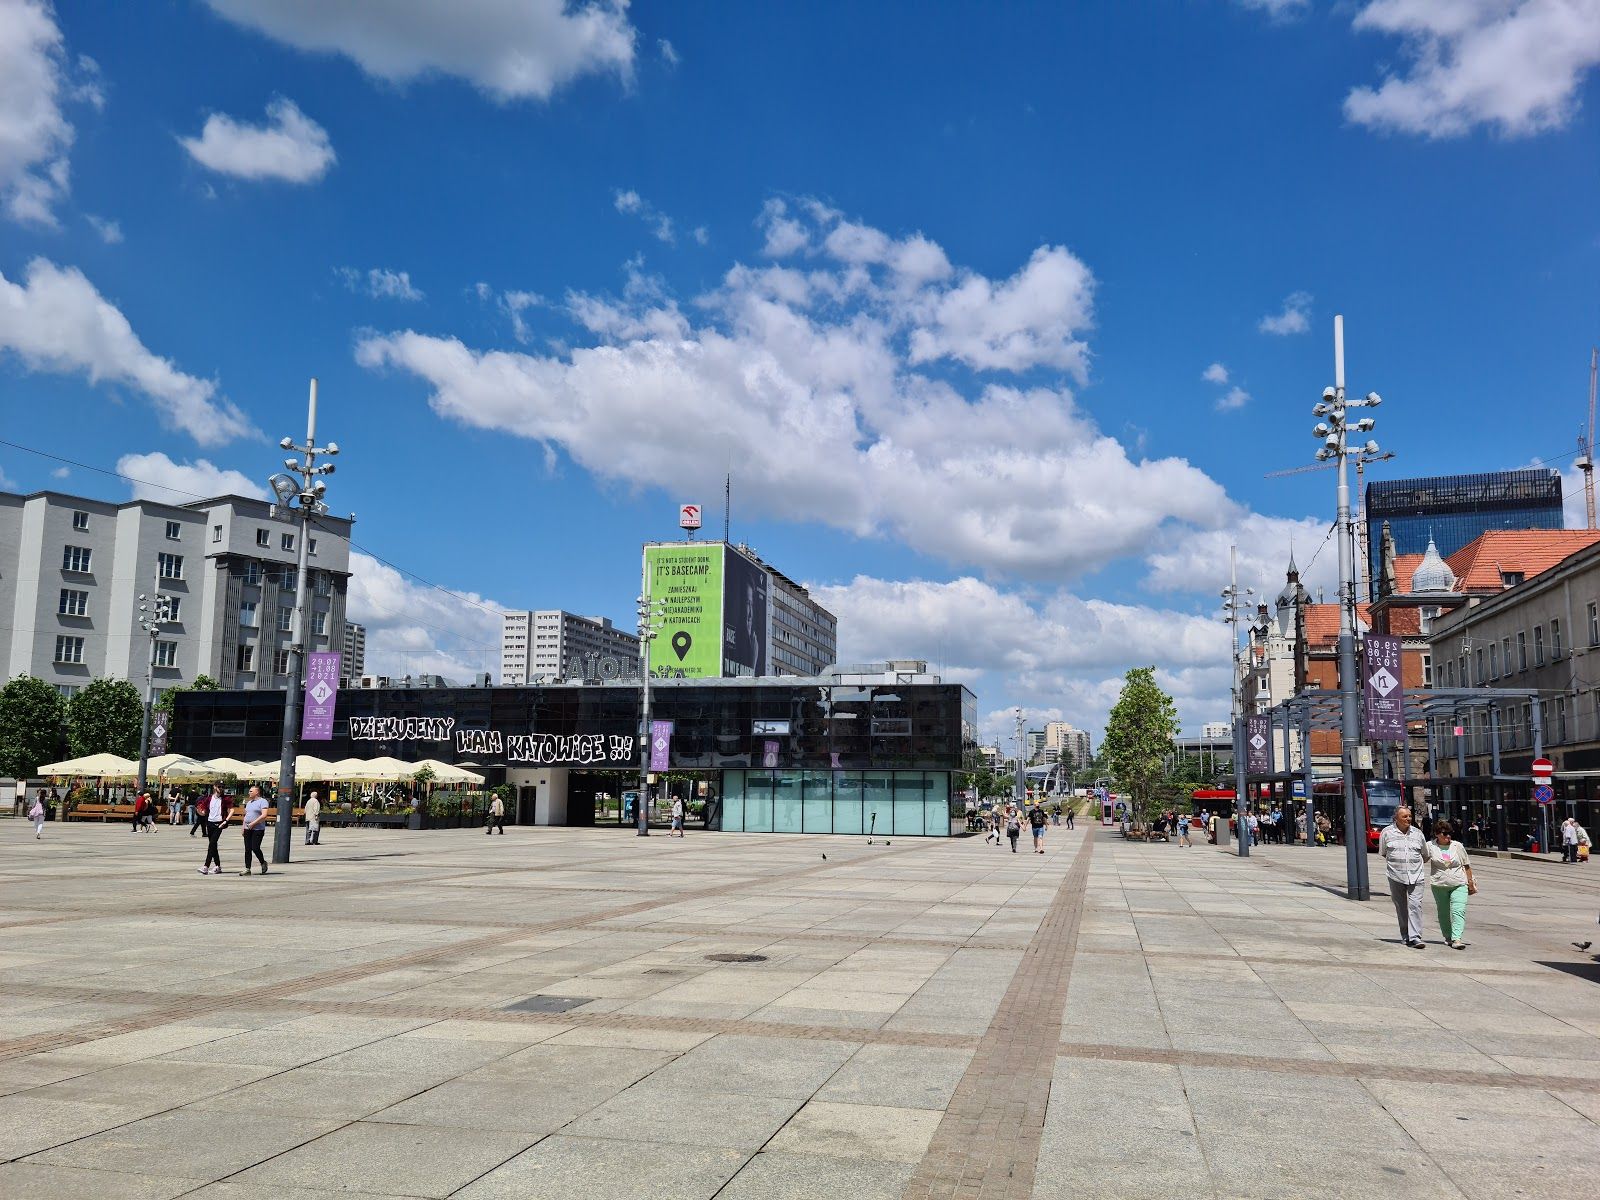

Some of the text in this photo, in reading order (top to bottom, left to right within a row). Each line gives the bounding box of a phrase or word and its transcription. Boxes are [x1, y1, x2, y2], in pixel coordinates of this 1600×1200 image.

[656, 565, 712, 576] IT'S BASECAMP.
[667, 585, 697, 593] ZAMIESZKAJ
[669, 616, 701, 624] KATOWICACH
[310, 672, 335, 680] 2021
[455, 730, 503, 753] WAM
